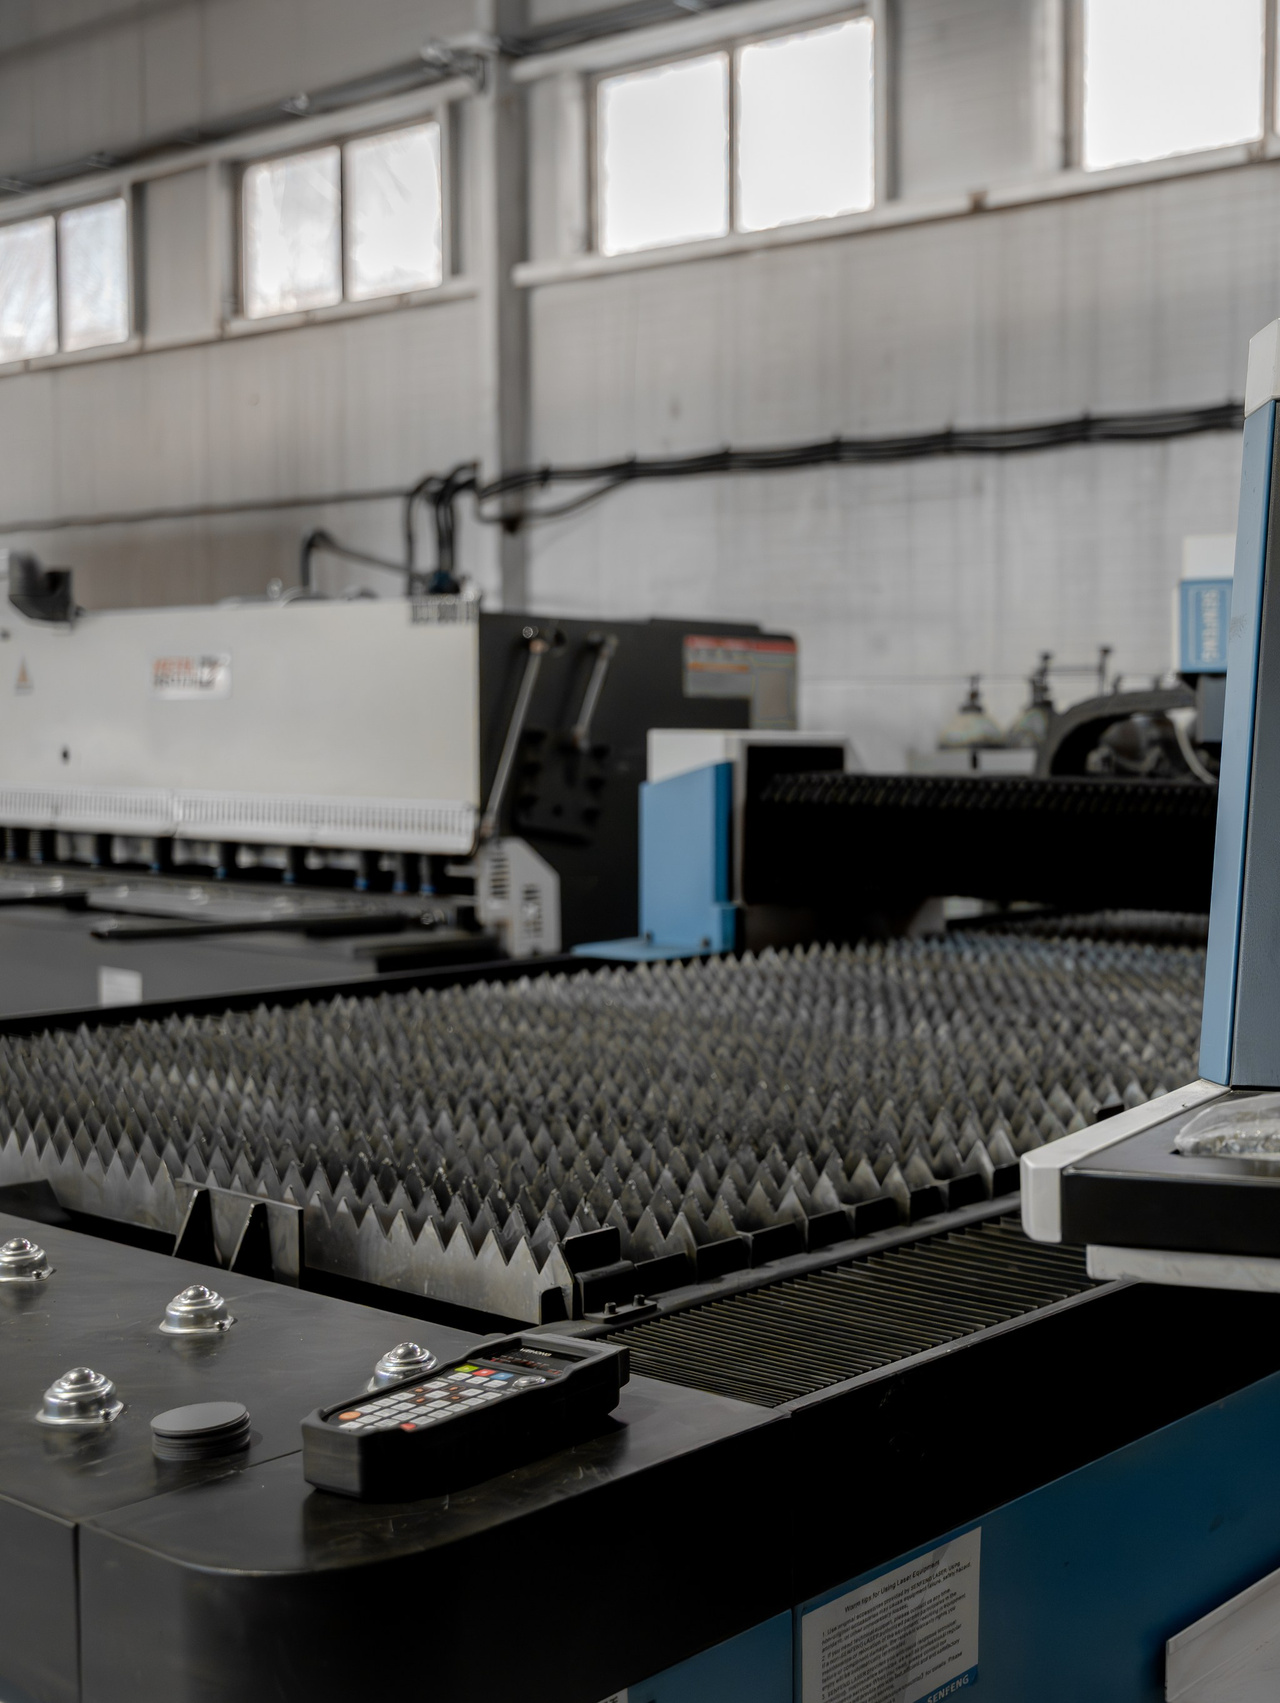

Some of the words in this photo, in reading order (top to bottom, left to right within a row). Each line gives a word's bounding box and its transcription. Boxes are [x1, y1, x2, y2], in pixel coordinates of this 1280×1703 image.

[845, 1599, 860, 1613] Warm
[861, 1593, 871, 1605] tips
[880, 1581, 895, 1595] Using
[896, 1573, 911, 1587] Laser
[912, 1559, 939, 1579] Equipment
